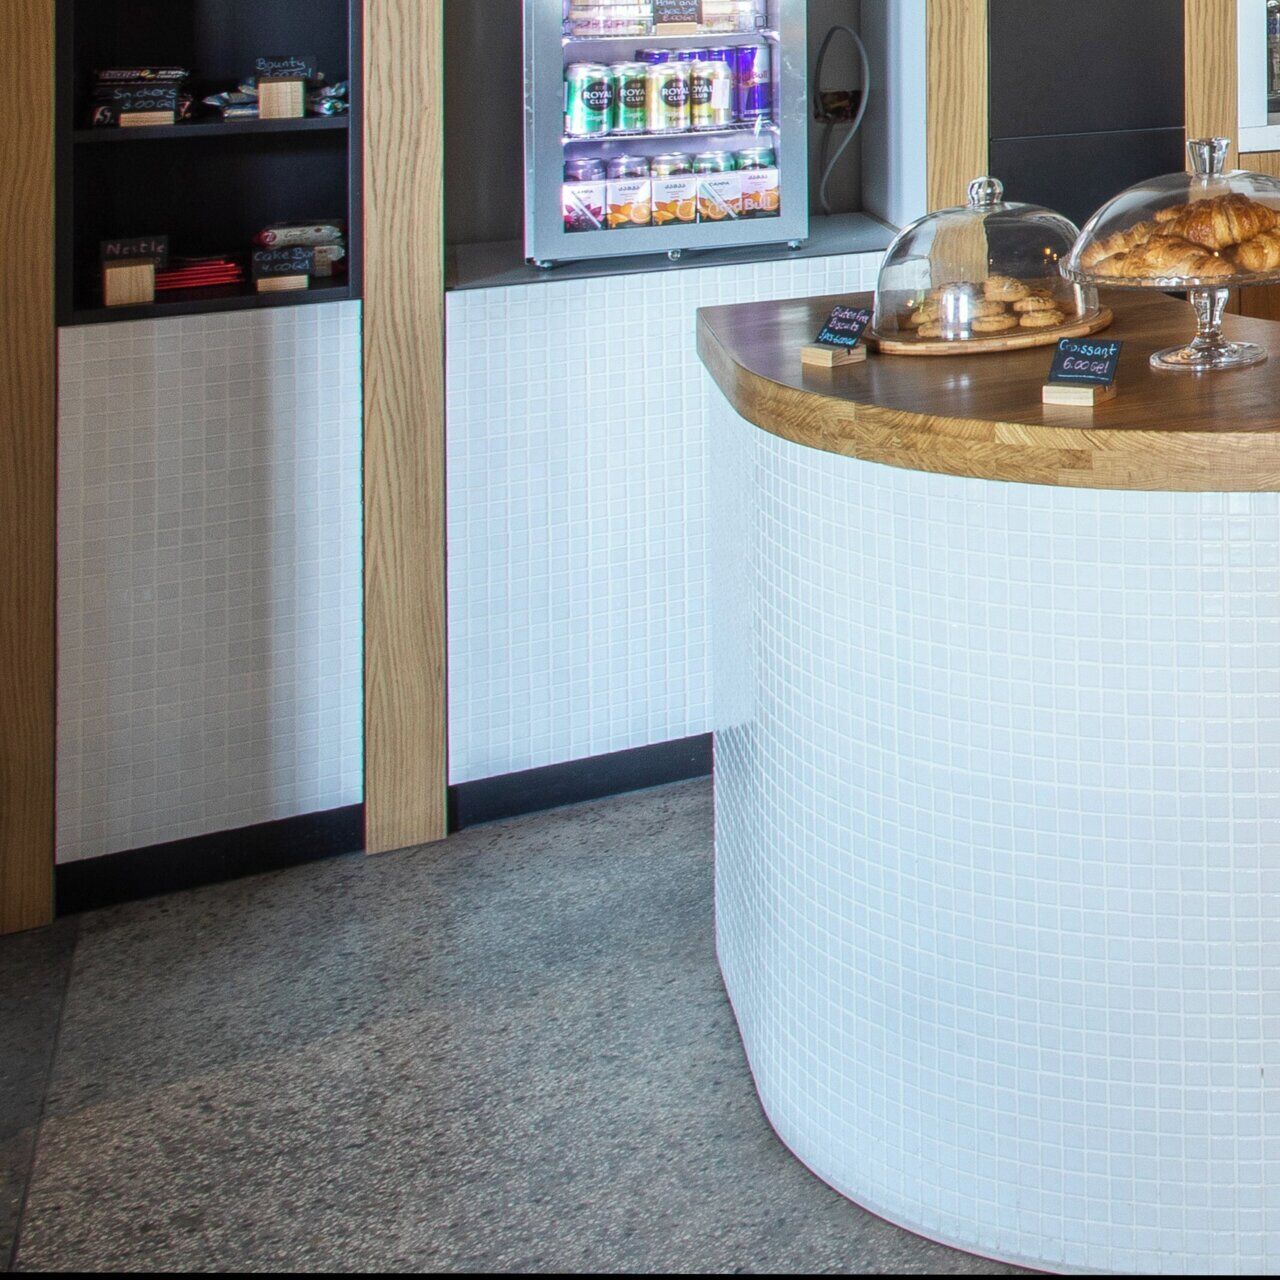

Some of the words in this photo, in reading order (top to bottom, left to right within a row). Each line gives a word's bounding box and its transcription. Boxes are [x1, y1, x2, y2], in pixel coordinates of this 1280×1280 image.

[255, 56, 306, 70] Bounty
[583, 90, 613, 99] ROYAL
[590, 97, 609, 105] CLUB
[106, 241, 165, 255] Nestle
[1059, 339, 1118, 358] Croissant
